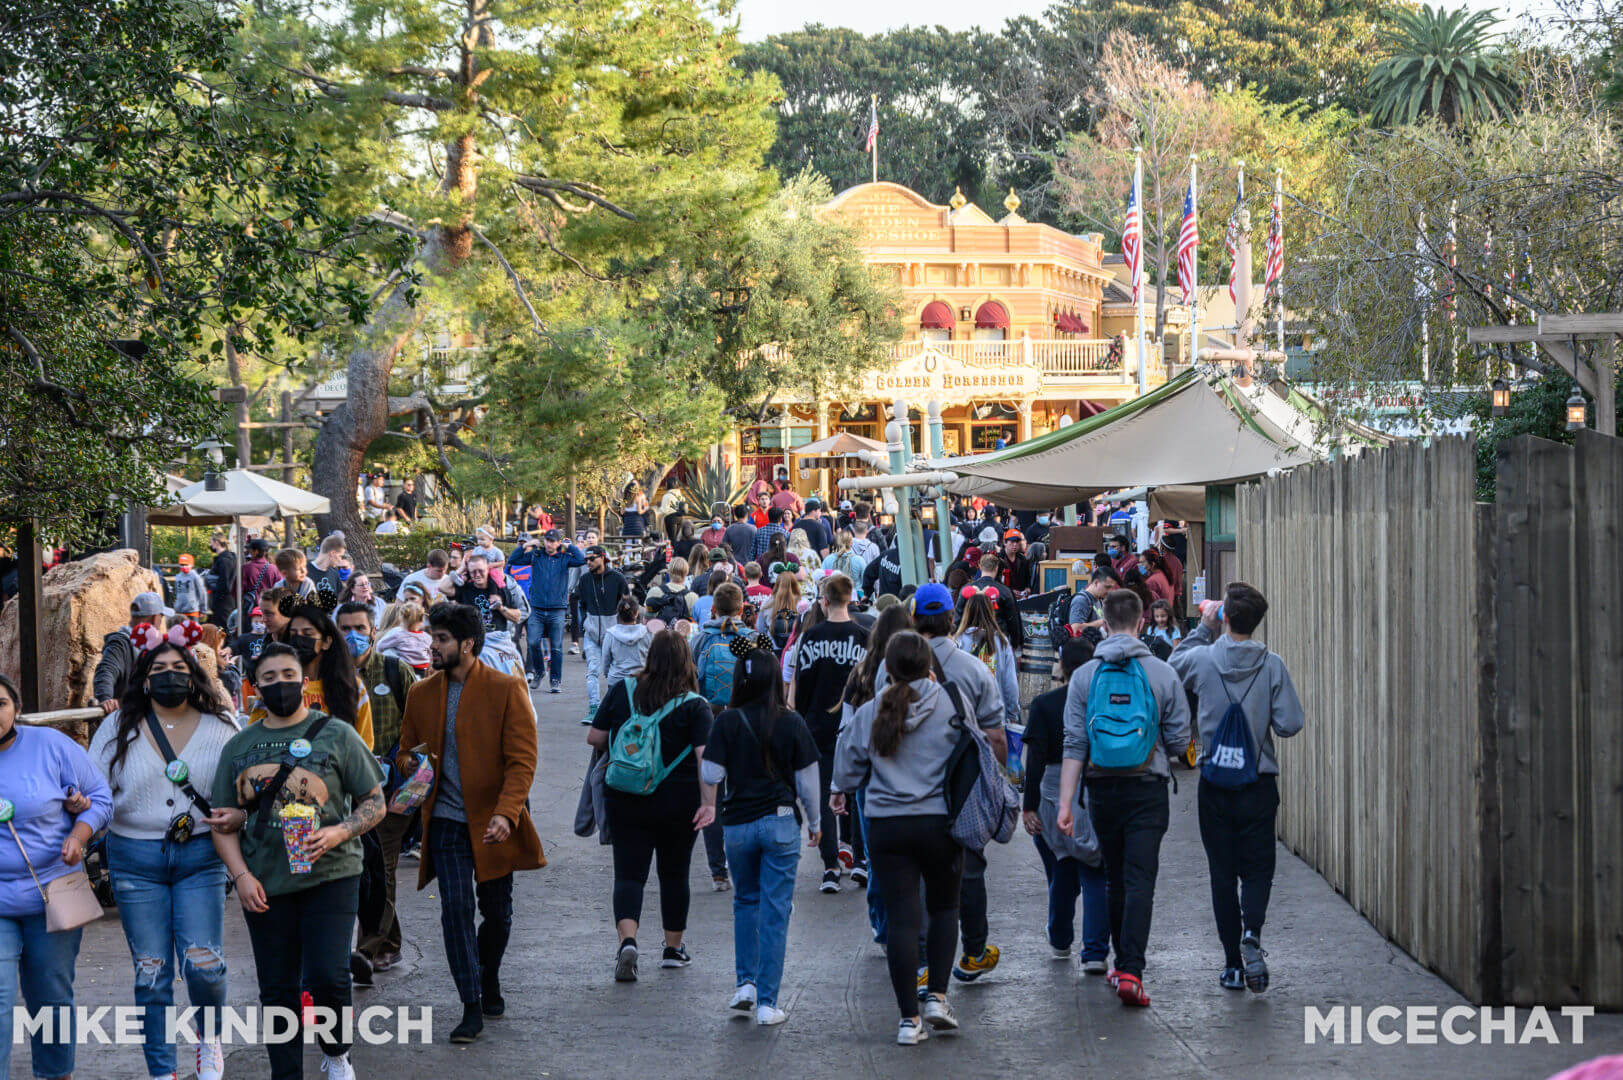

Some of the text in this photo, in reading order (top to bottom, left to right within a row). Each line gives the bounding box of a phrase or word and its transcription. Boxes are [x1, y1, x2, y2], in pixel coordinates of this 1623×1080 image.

[861, 204, 900, 216] THE
[876, 374, 1025, 390] GOLDEN HORSESHOE
